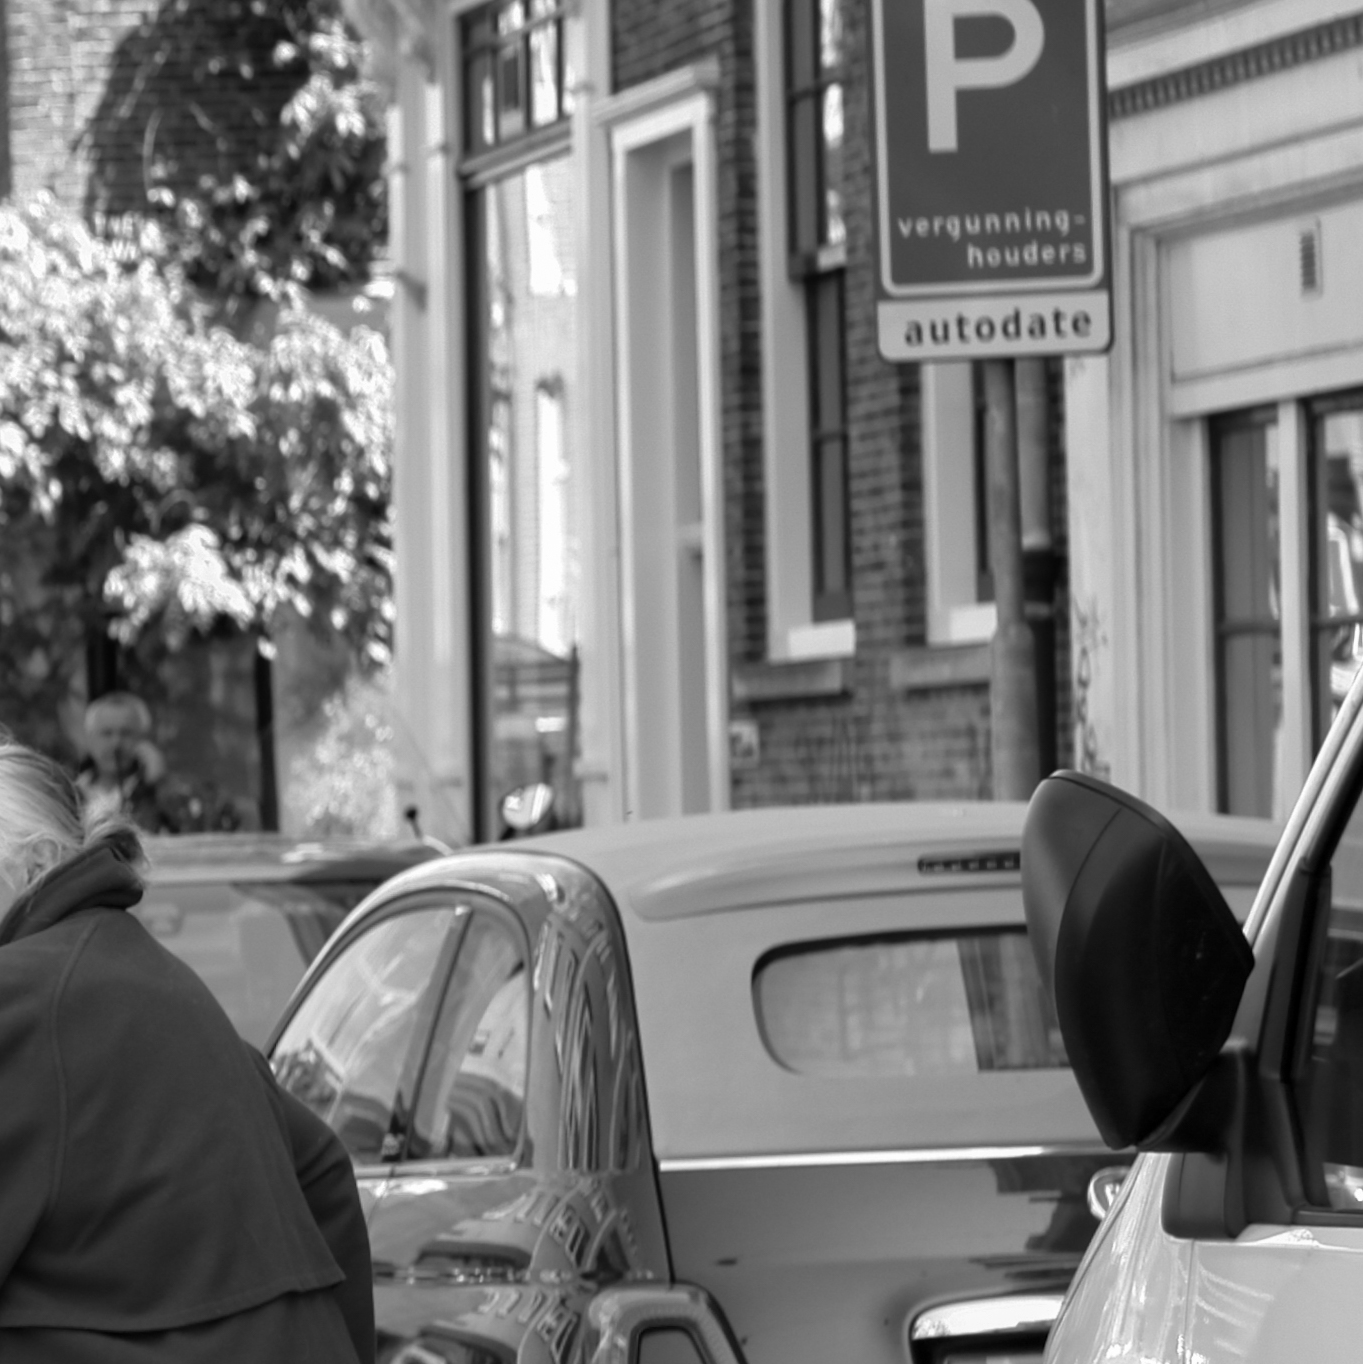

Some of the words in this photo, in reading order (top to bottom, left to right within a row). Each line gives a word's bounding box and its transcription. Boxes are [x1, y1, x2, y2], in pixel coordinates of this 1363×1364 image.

[924, 0, 1045, 153] P
[898, 206, 1087, 243] vergunning-
[966, 237, 1087, 270] houders
[905, 306, 1092, 347] autodate
